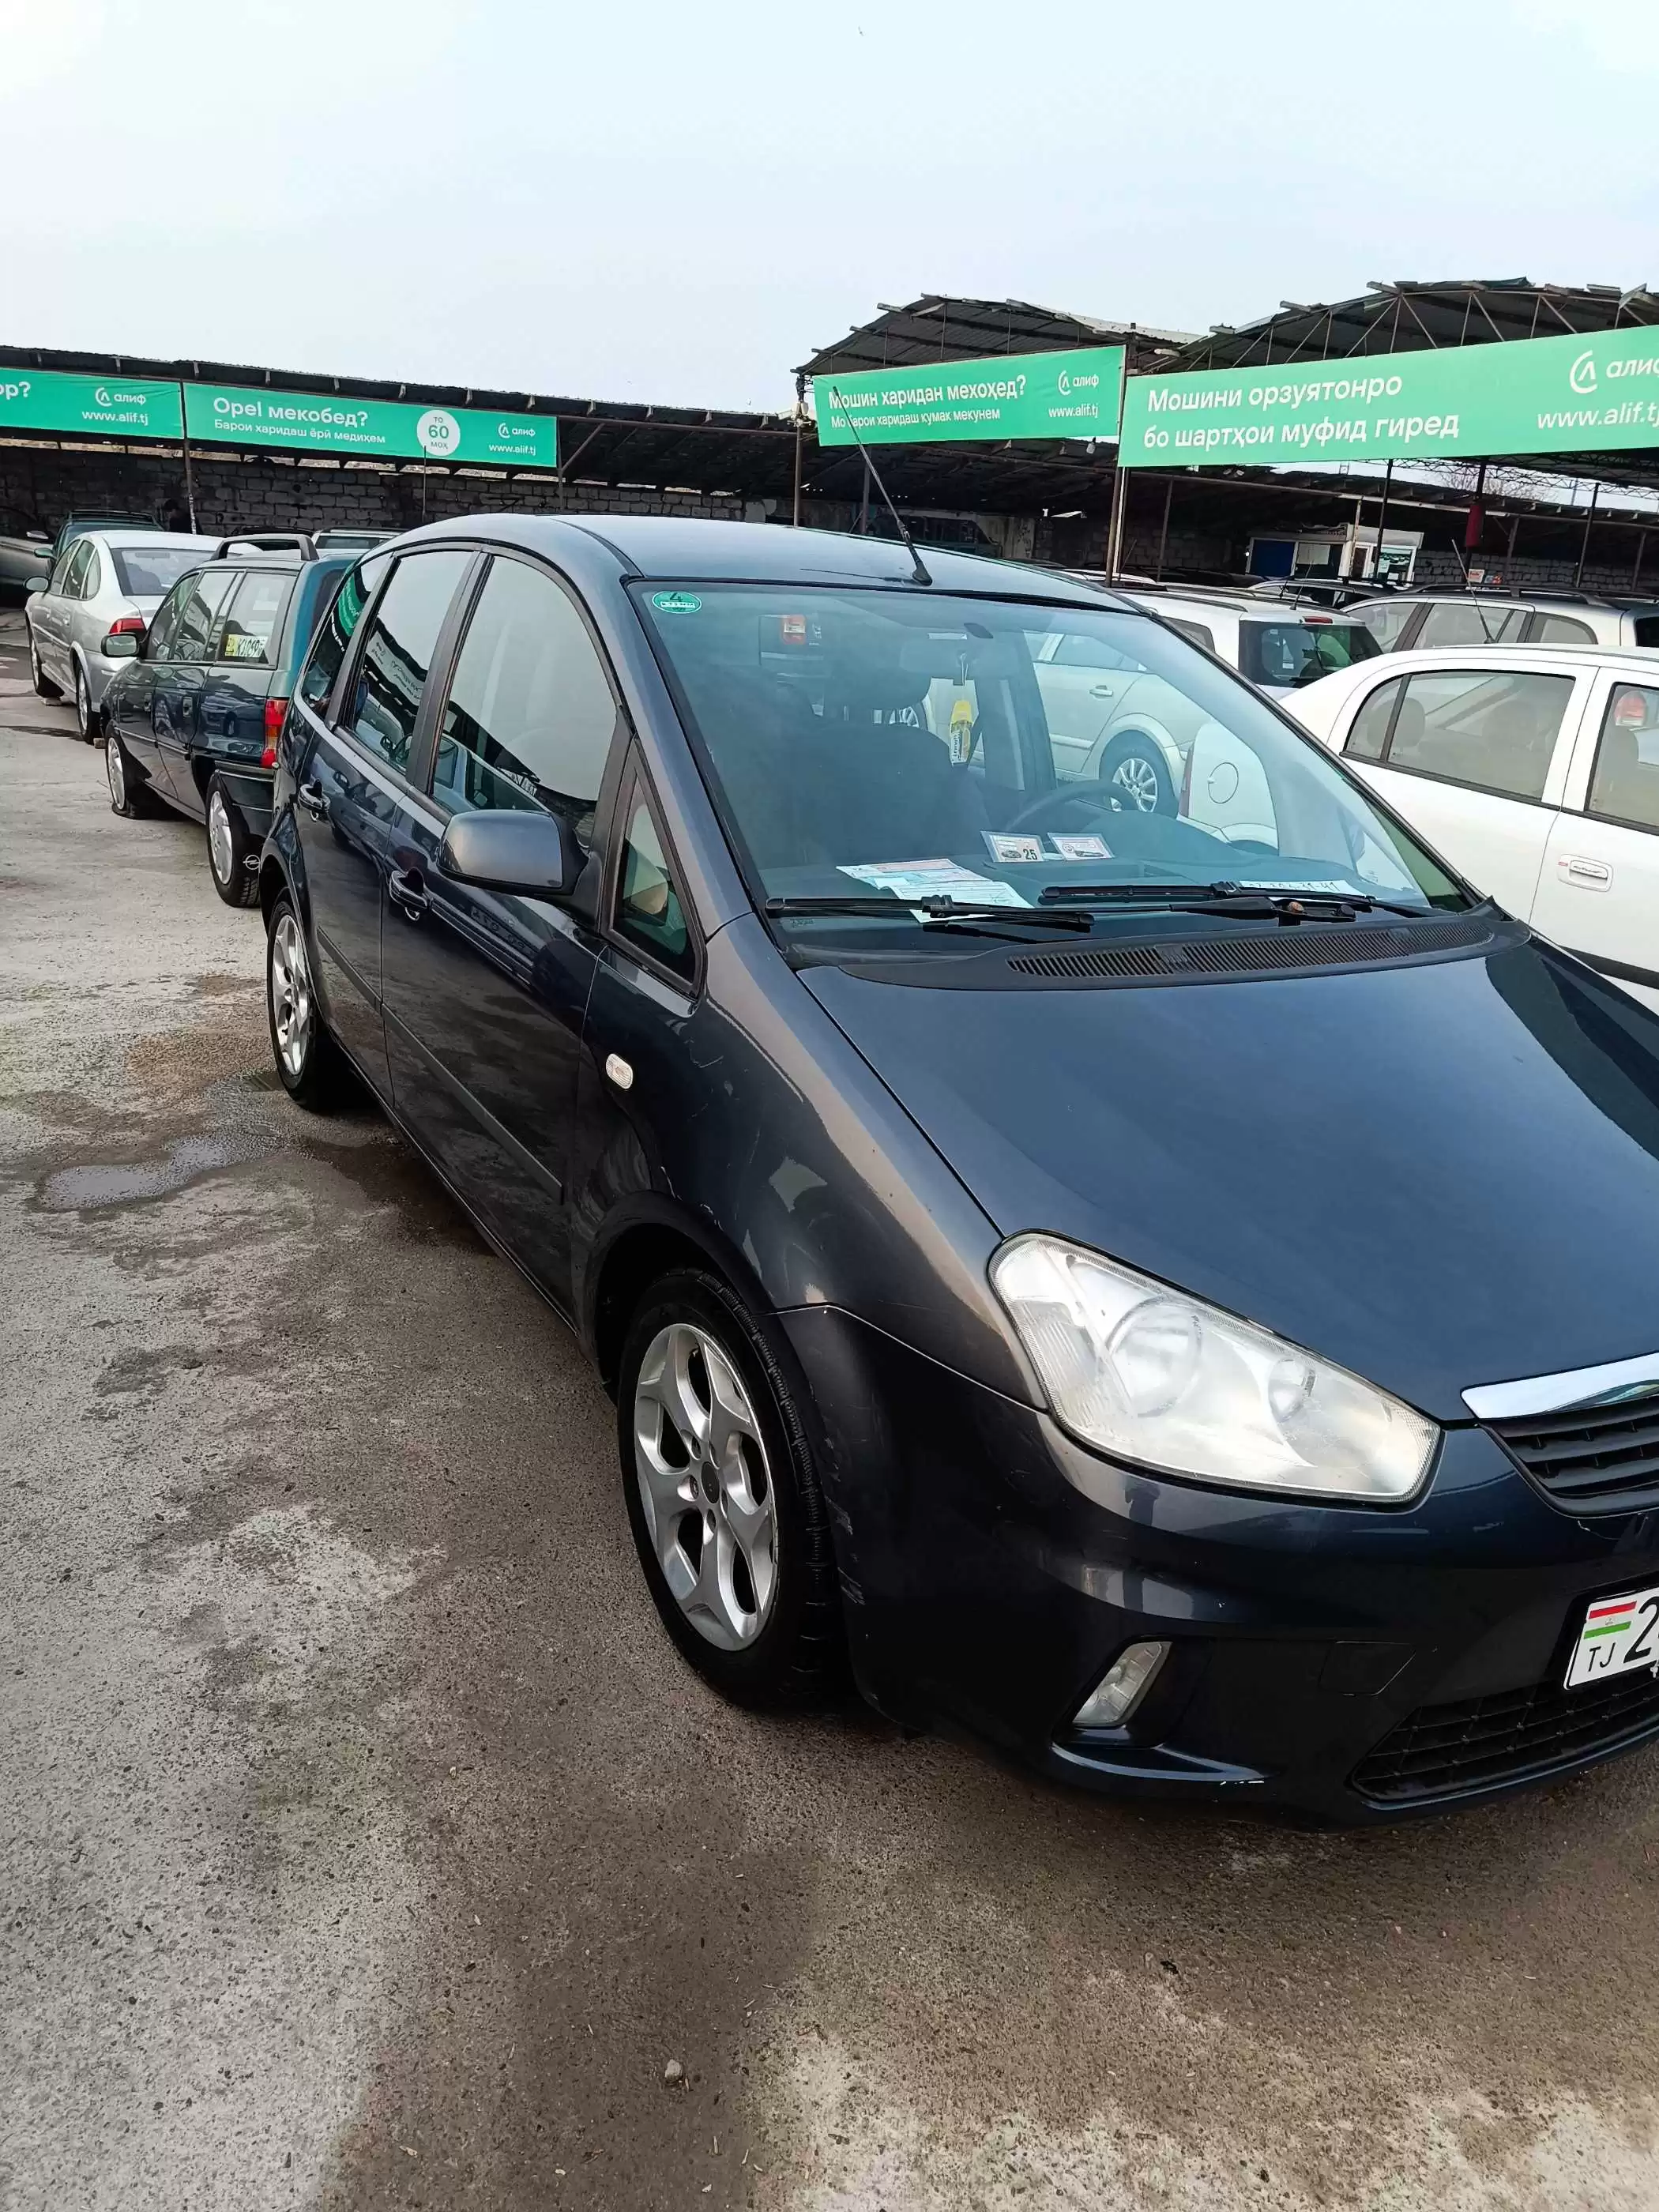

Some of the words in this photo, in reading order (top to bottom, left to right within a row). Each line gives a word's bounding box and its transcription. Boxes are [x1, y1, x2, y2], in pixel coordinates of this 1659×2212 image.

[1072, 374, 1100, 388] алиф
[114, 393, 146, 405] алиф
[828, 391, 878, 409] Мошин
[881, 386, 943, 408] харидан
[946, 374, 1026, 401] мехоҳед?
[1148, 388, 1243, 412] Мошини
[1248, 373, 1402, 411] орзуятонро
[81, 411, 149, 426] www.alif.tj
[213, 397, 262, 418] Opel
[268, 406, 368, 428] мекобед?
[831, 416, 846, 427] Мо
[877, 415, 920, 428] харидаш
[953, 408, 1000, 423] мекунем
[1048, 404, 1098, 419] www.alif.tj
[214, 419, 253, 434] Барои
[255, 424, 307, 438] харидаш
[428, 424, 450, 438] 60
[511, 427, 536, 438] алиф
[1144, 425, 1169, 448] бо
[1175, 425, 1274, 451] шартҳои
[1281, 416, 1367, 448] муфид
[1375, 412, 1459, 442] гиред
[488, 443, 536, 456] www.alif.tj
[1022, 848, 1038, 860] 25
[1588, 1642, 1616, 1672] TJ
